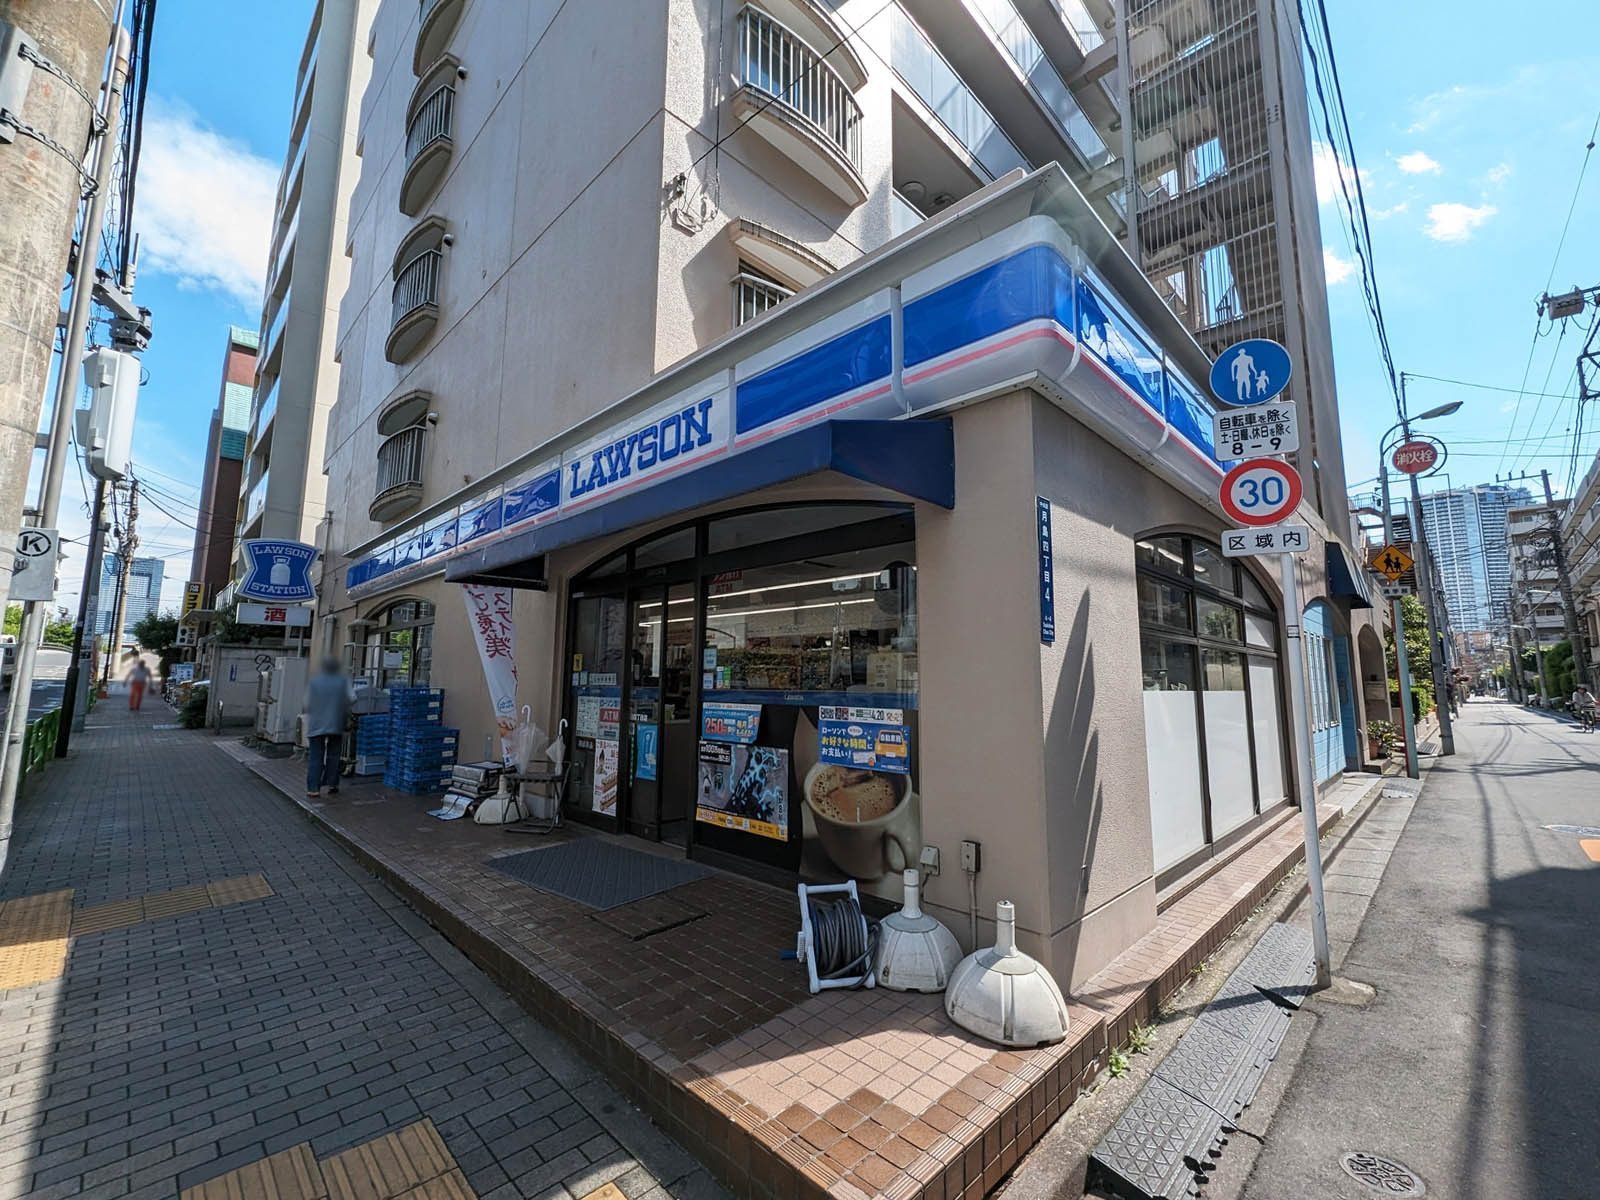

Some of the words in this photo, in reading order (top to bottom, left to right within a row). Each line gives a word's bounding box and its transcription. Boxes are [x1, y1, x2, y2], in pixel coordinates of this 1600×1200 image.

[1219, 410, 1290, 430] 自転車を除く
[570, 398, 712, 499] LAWSON
[1396, 449, 1433, 466] 消火栓
[1238, 475, 1284, 508] 30
[22, 535, 44, 553] K
[1228, 532, 1302, 551] 区域内
[253, 546, 310, 559] LAWSON
[250, 582, 306, 595] STATION
[264, 607, 288, 623] 酒
[821, 727, 847, 736] ローソンで
